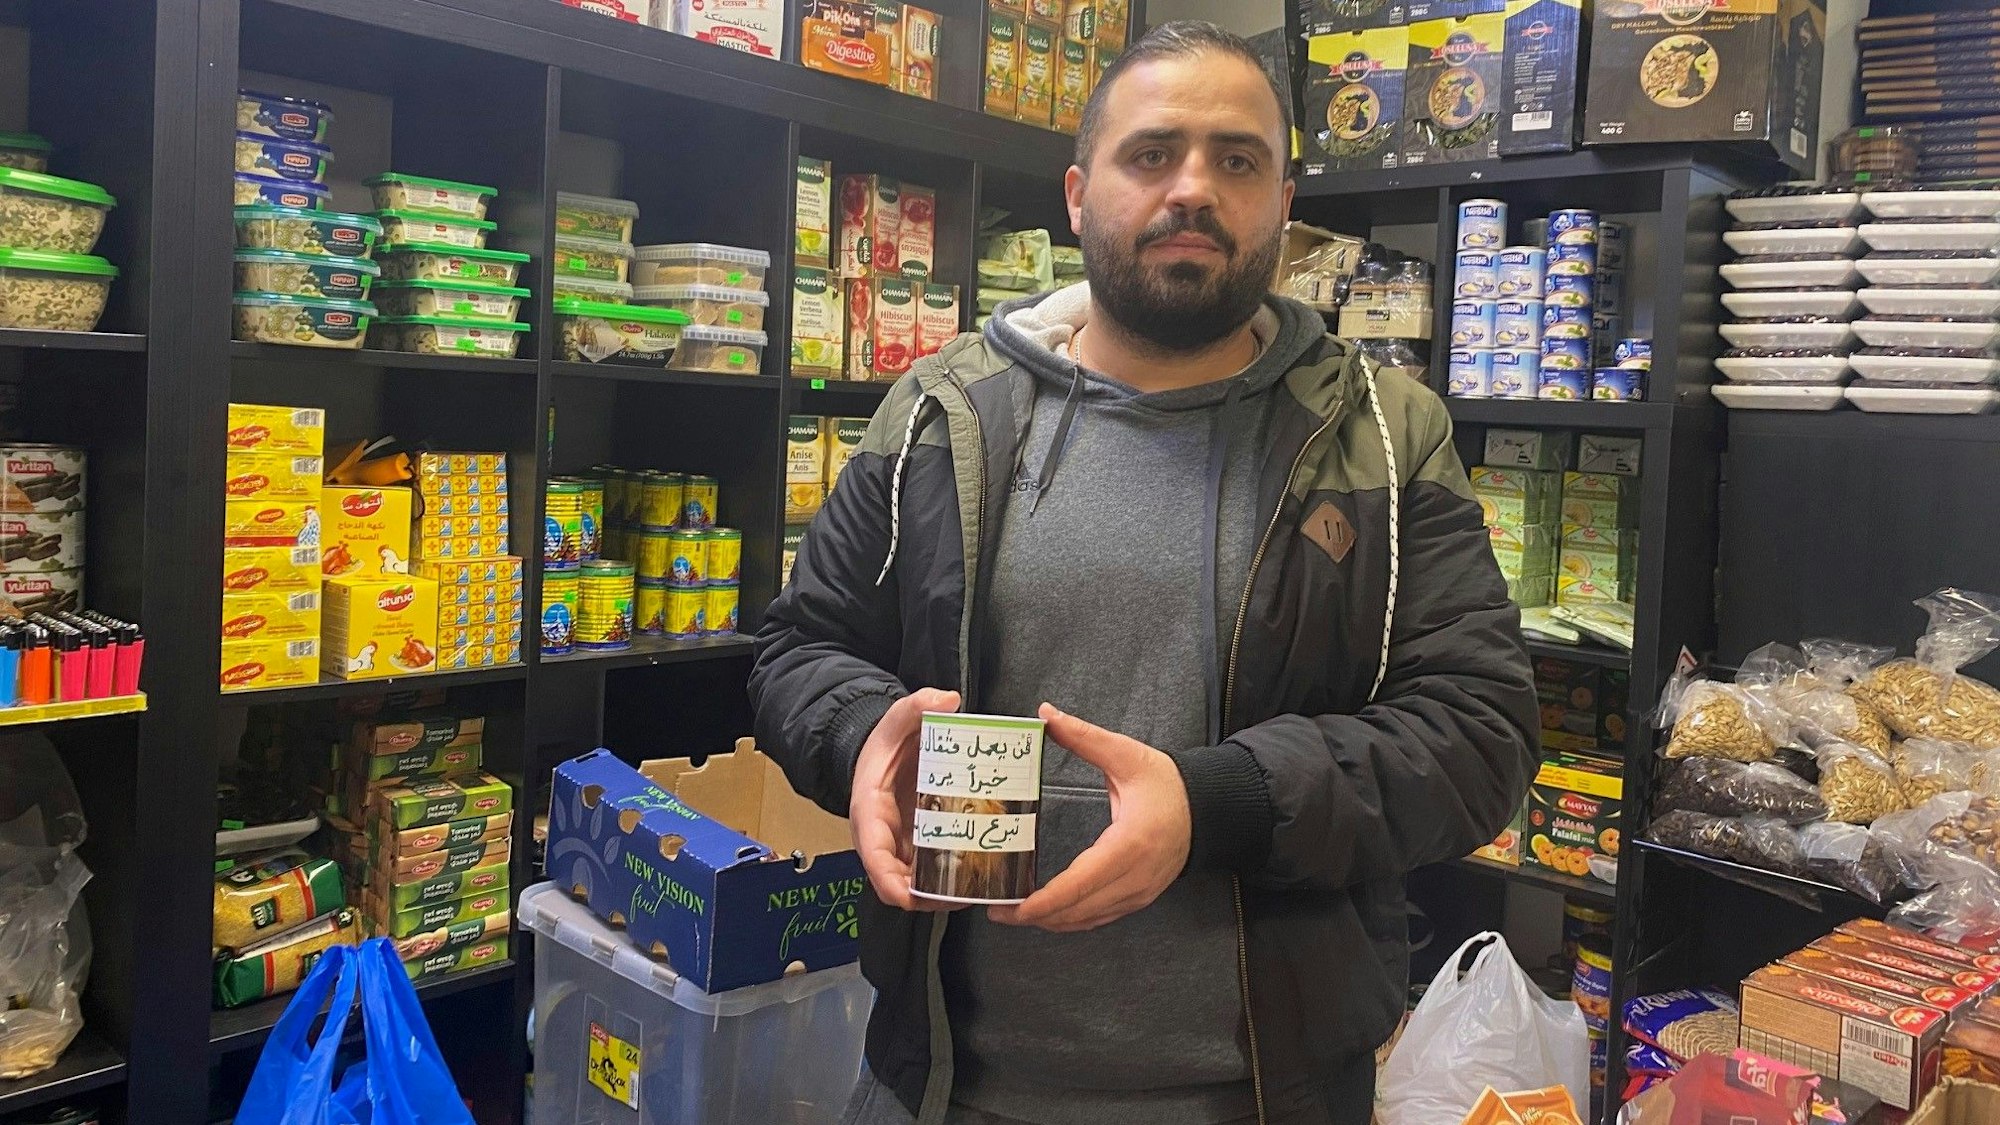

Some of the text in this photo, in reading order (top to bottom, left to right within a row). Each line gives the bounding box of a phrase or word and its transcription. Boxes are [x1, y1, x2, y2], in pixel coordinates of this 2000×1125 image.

[1627, 20, 1658, 29] MALLOW
[719, 39, 749, 52] MASTIC
[826, 40, 876, 64] Digestive
[800, 187, 819, 197] Lemon
[800, 306, 822, 314] Verbena
[880, 311, 912, 321] Hibiscus
[922, 315, 955, 325] Hibiscus
[645, 330, 676, 339] Halawa
[790, 450, 813, 460] Anise
[10, 462, 52, 474] yurttan
[337, 521, 364, 530] الدجاج
[8, 580, 50, 592] yurttan
[378, 592, 415, 609] altunsa
[967, 735, 1007, 760] يعمل
[929, 772, 954, 786] يره
[1566, 801, 1598, 813] MAYYAS
[1552, 827, 1596, 844] Falafel mix
[625, 851, 705, 917] NEW VISION
[630, 882, 675, 923] fruit
[767, 884, 820, 913] NEW
[779, 900, 858, 962] fruit
[626, 1048, 638, 1065] 24
